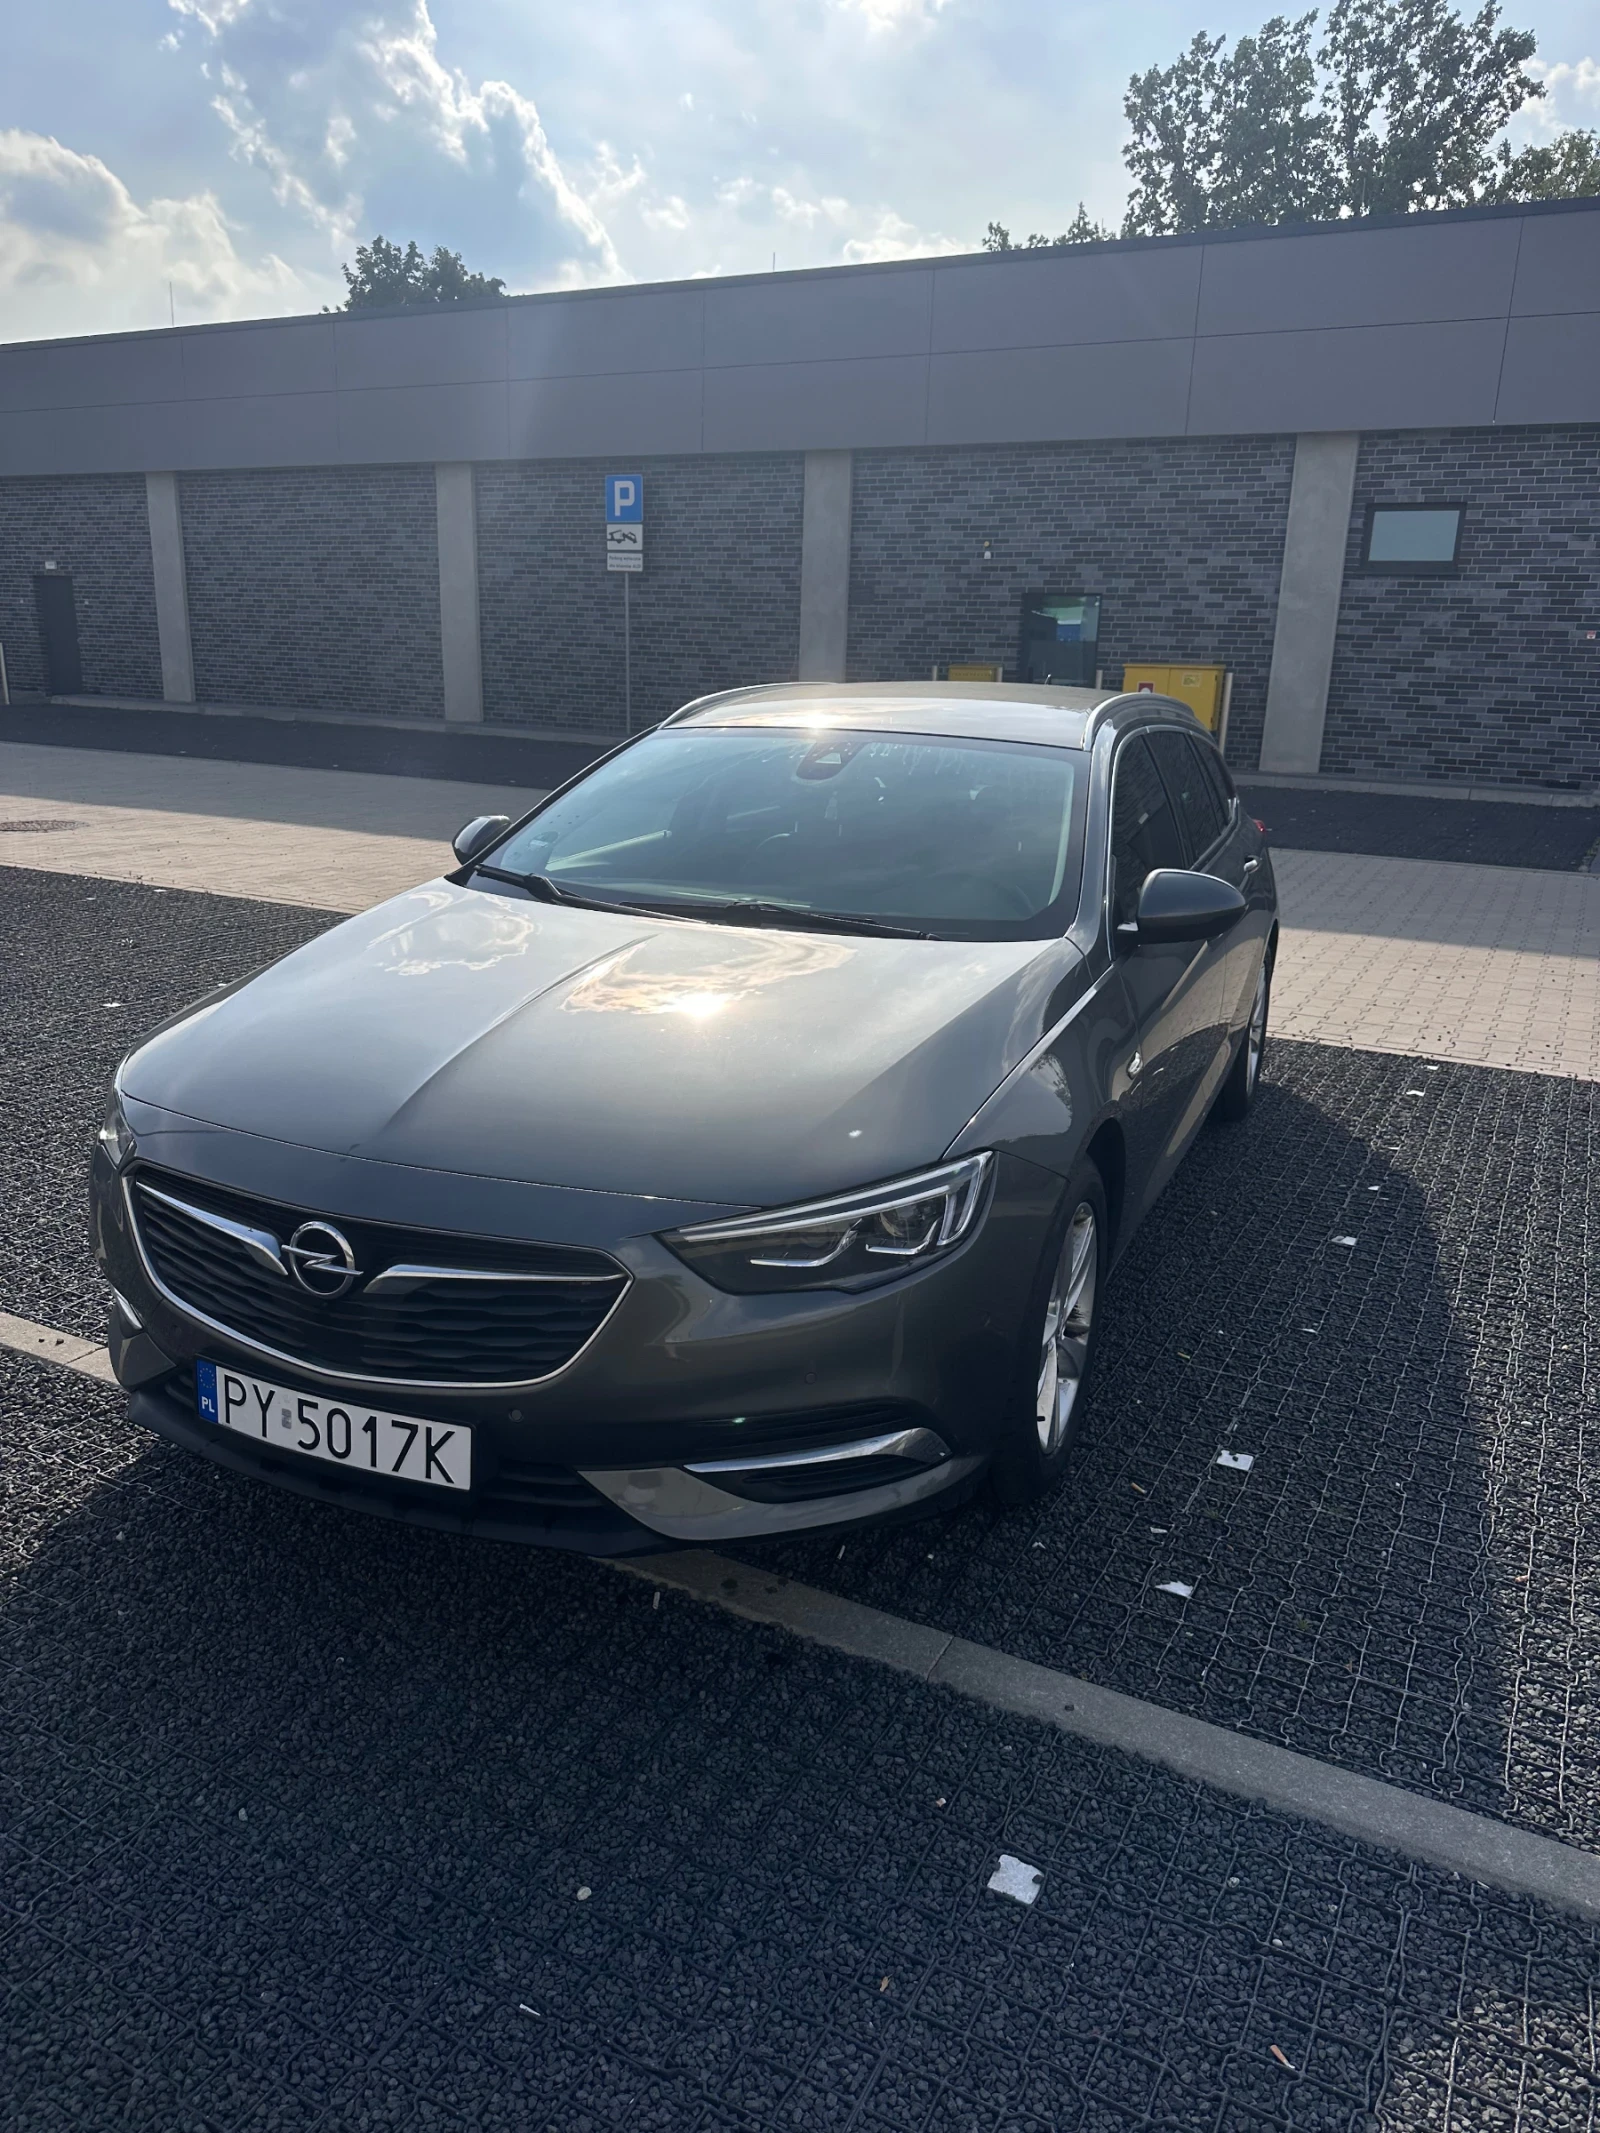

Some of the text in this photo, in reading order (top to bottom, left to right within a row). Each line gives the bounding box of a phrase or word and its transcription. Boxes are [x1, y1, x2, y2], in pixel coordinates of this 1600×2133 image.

[614, 480, 635, 517] P
[201, 1395, 216, 1414] PL
[223, 1373, 456, 1484] PY 5017K
